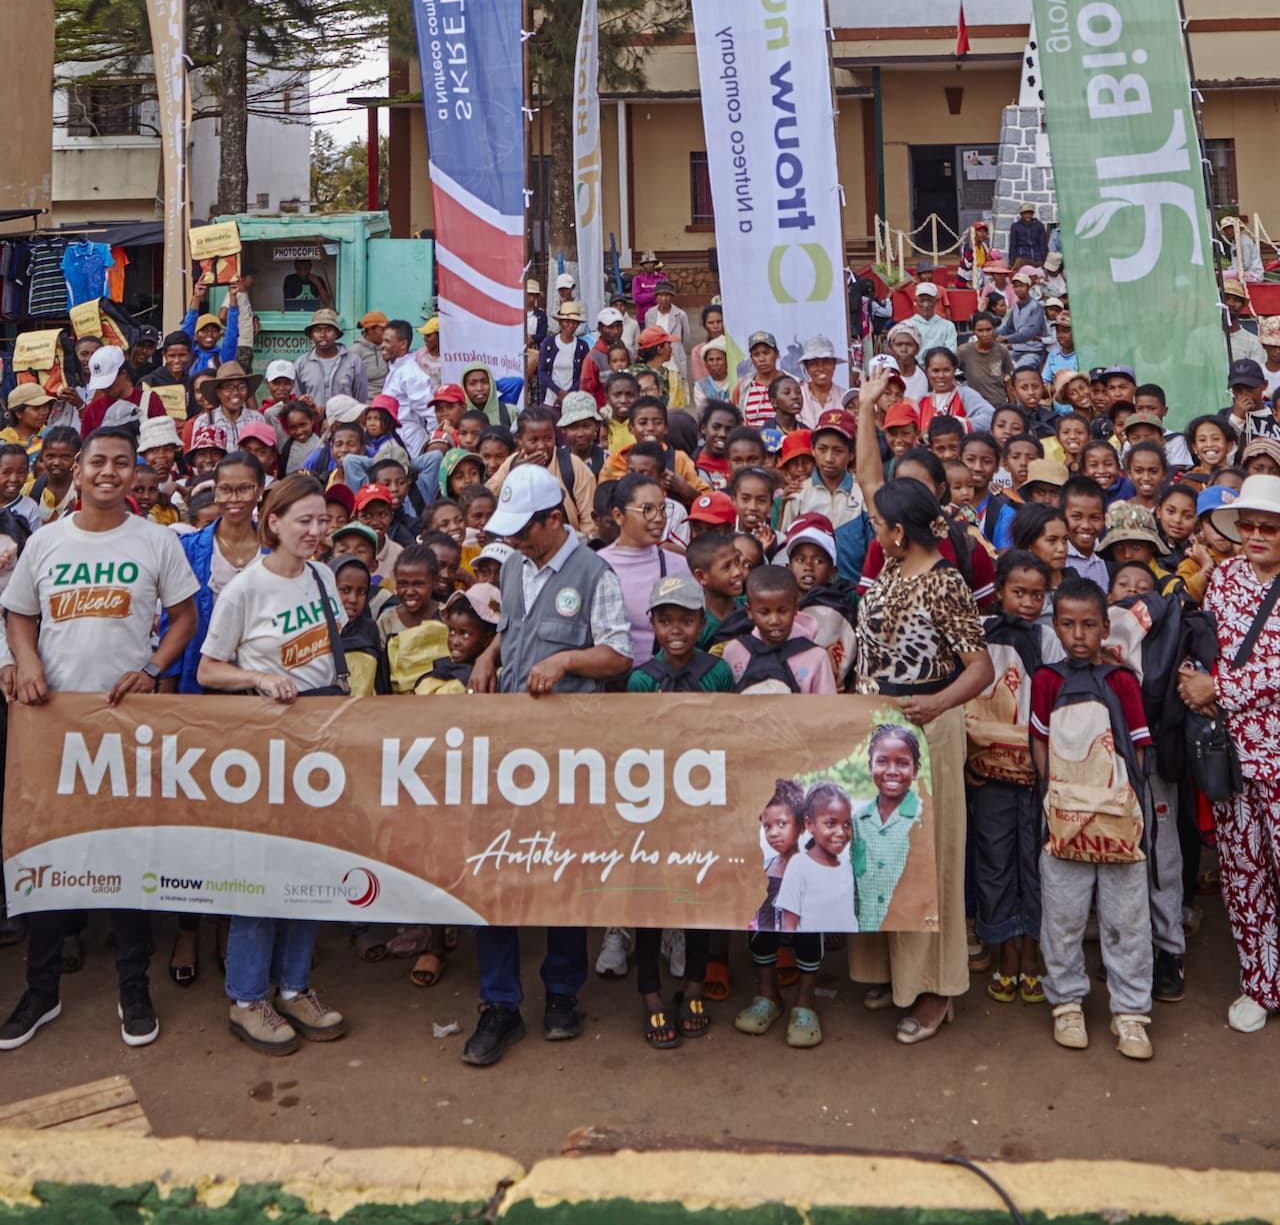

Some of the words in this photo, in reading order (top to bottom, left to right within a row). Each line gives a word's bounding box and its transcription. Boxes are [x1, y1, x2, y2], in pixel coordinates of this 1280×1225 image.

[274, 247, 320, 258] PHOTOCOPIE
[57, 587, 124, 618] Mikolo
[57, 724, 347, 808] Mikolo
[380, 726, 727, 823] Kilonga
[466, 829, 577, 883] Antoky
[581, 849, 625, 883] ny
[629, 830, 661, 867] ho
[667, 849, 721, 885] avy
[51, 870, 122, 888] Biochem
[160, 875, 203, 890] trouw
[205, 879, 265, 895] nutrition
[91, 886, 121, 894] GROUP
[284, 883, 358, 898] SKRETTING
